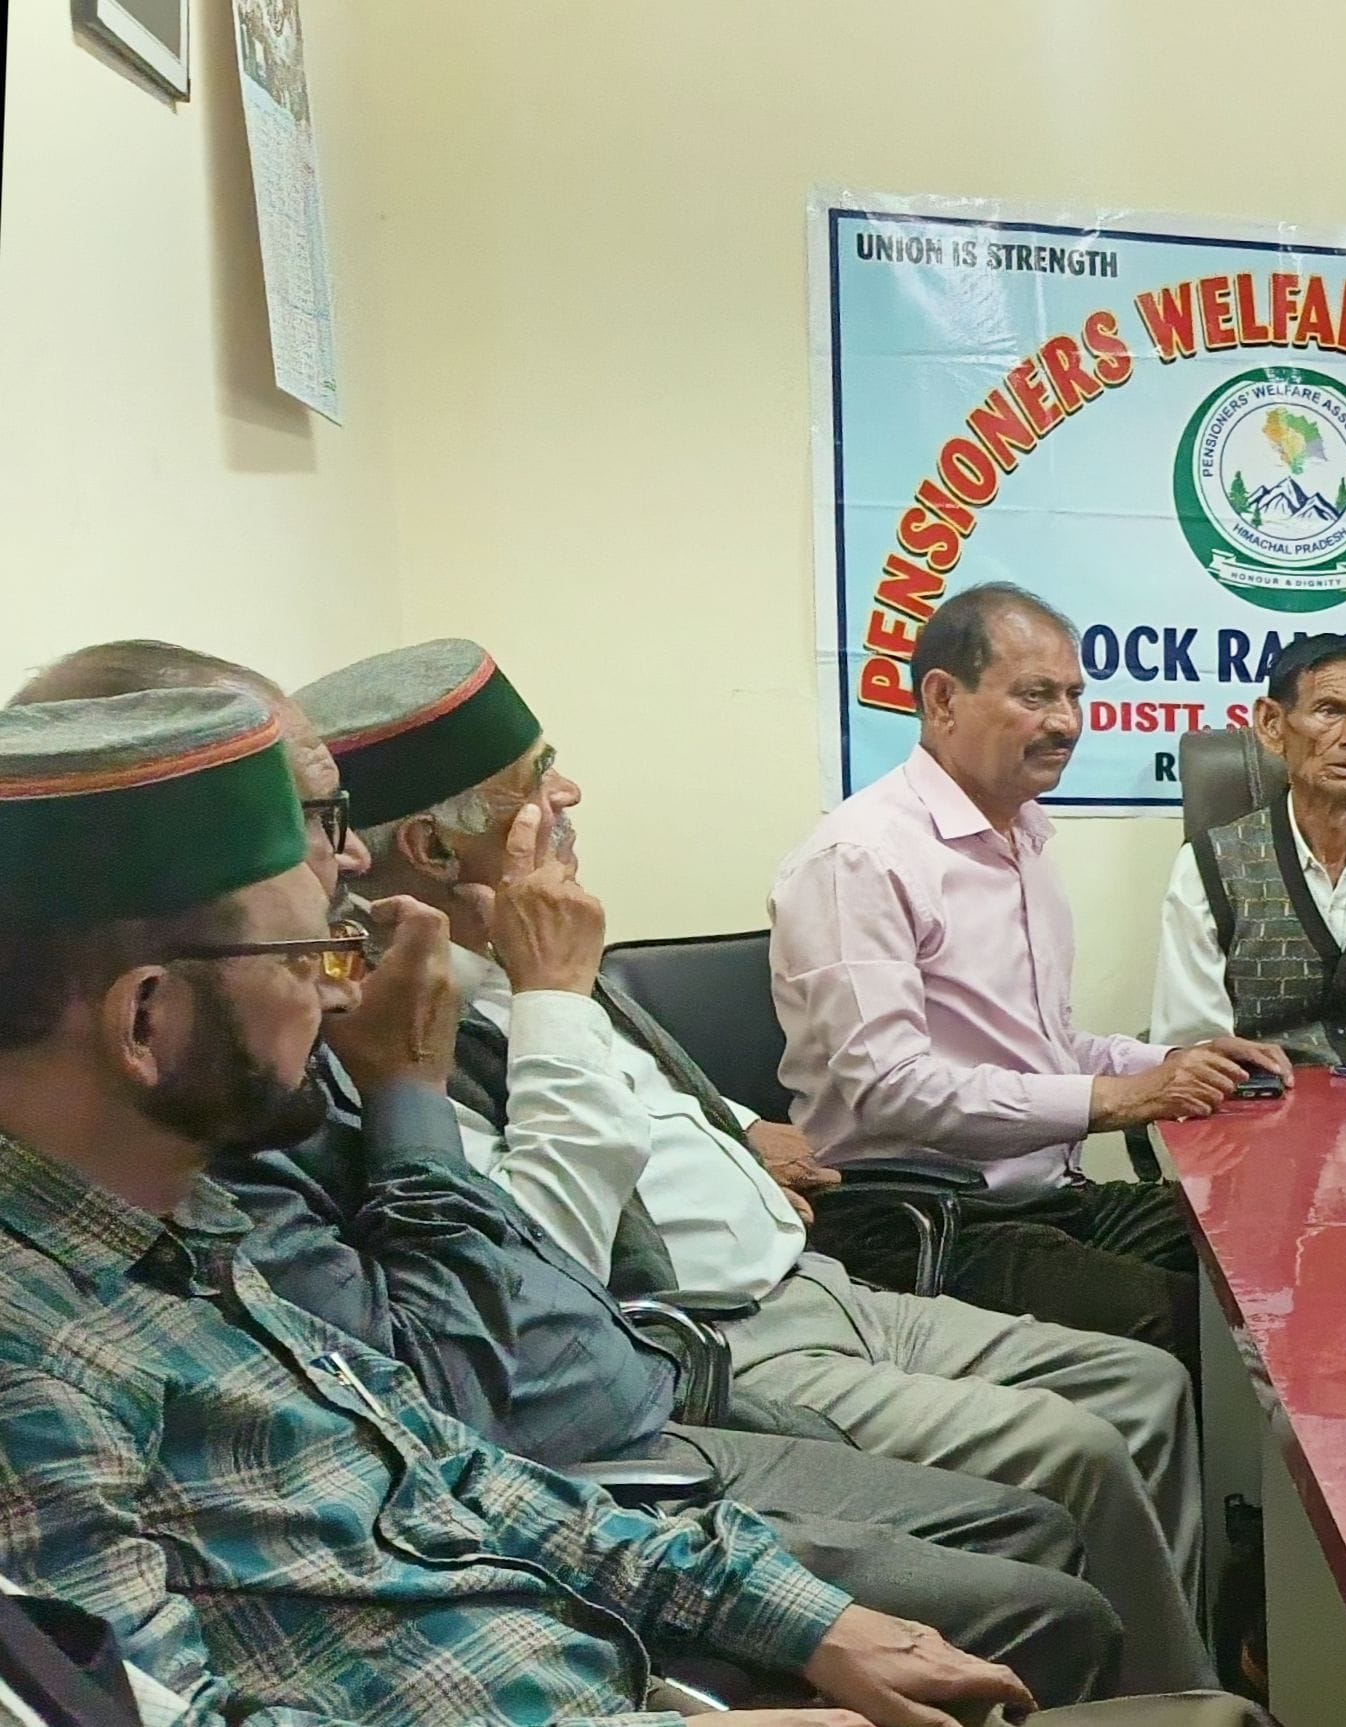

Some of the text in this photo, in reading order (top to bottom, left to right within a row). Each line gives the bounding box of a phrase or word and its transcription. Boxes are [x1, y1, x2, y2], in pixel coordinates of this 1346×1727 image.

[857, 233, 1118, 278] UNION IS STRENGTH
[1202, 390, 1251, 478] PENSIONERS'
[1252, 384, 1322, 405] WELFARE
[858, 309, 1134, 719] PENSIONERS
[1232, 523, 1293, 555] HIMACHAL
[1231, 572, 1279, 585] HONOUR
[1295, 579, 1341, 587] DIGNITY
[1082, 624, 1200, 683] OCK
